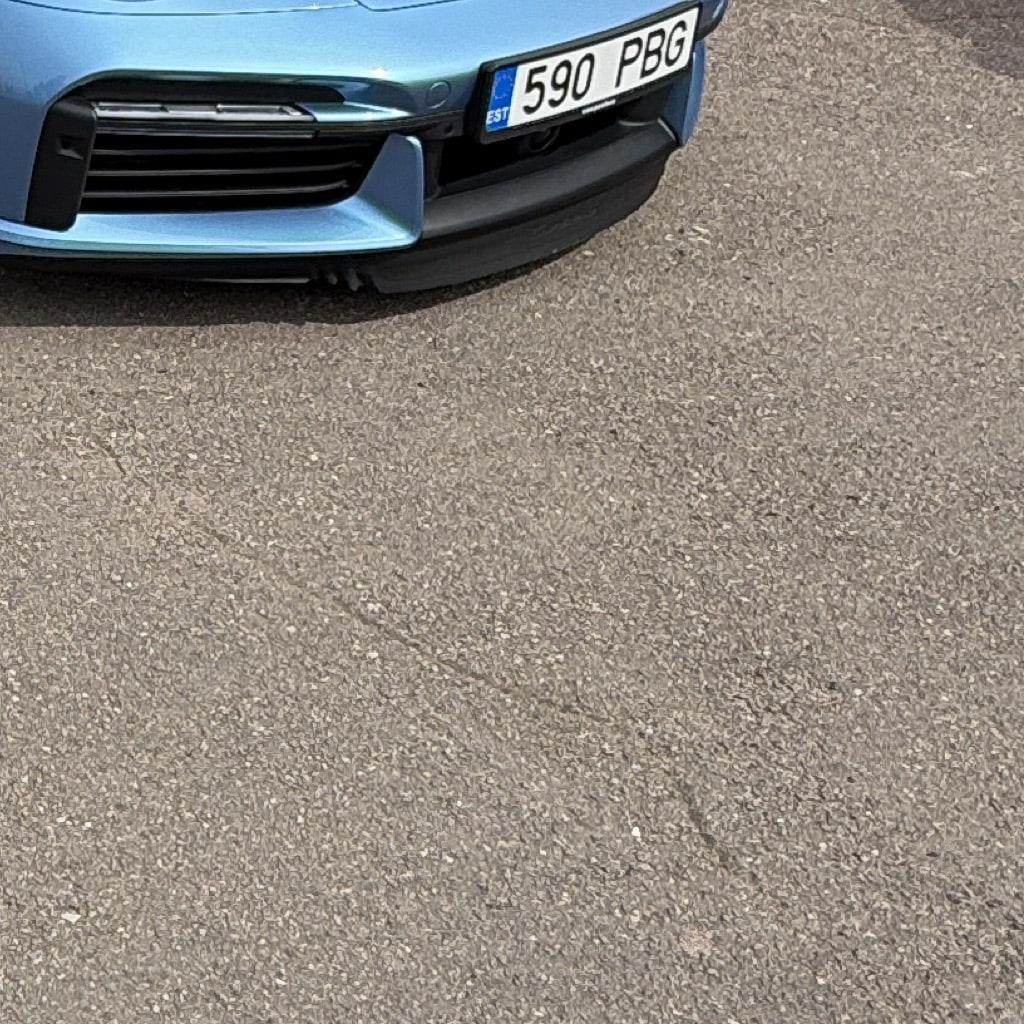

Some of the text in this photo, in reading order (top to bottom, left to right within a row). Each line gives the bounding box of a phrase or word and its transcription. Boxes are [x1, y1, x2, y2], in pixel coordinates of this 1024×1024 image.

[486, 20, 688, 124] EST 590 PBG
